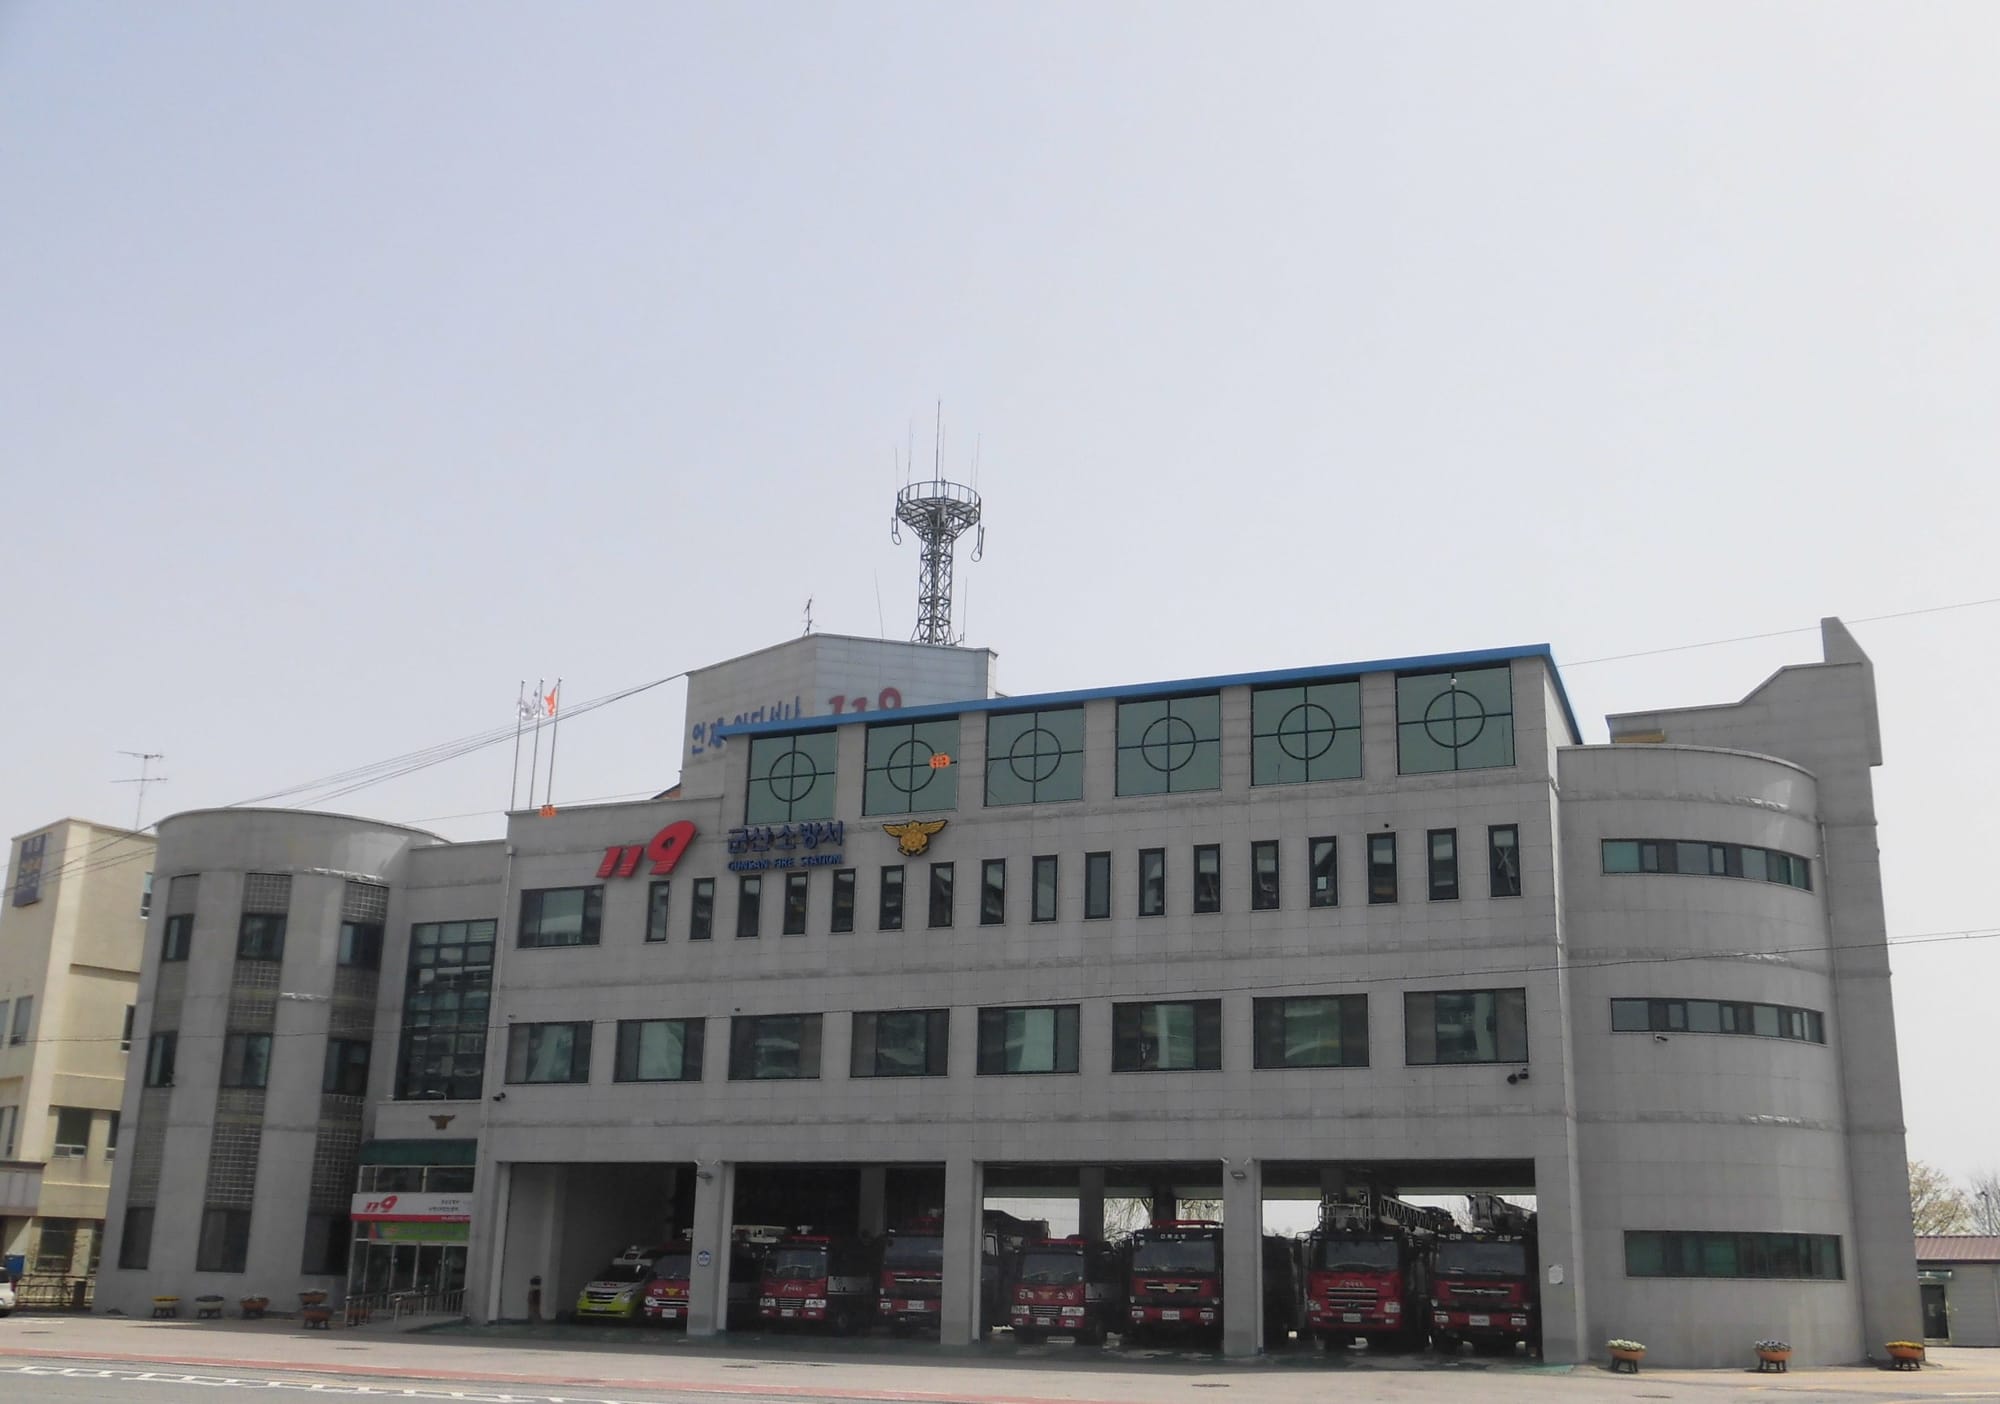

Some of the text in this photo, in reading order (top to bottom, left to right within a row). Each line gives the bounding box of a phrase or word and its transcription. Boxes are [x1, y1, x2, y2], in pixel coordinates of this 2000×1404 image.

[596, 820, 698, 878] 119
[728, 820, 844, 854] 군산소방서
[728, 854, 842, 872] GUNSAN FIRE STATION
[364, 1195, 399, 1212] 119
